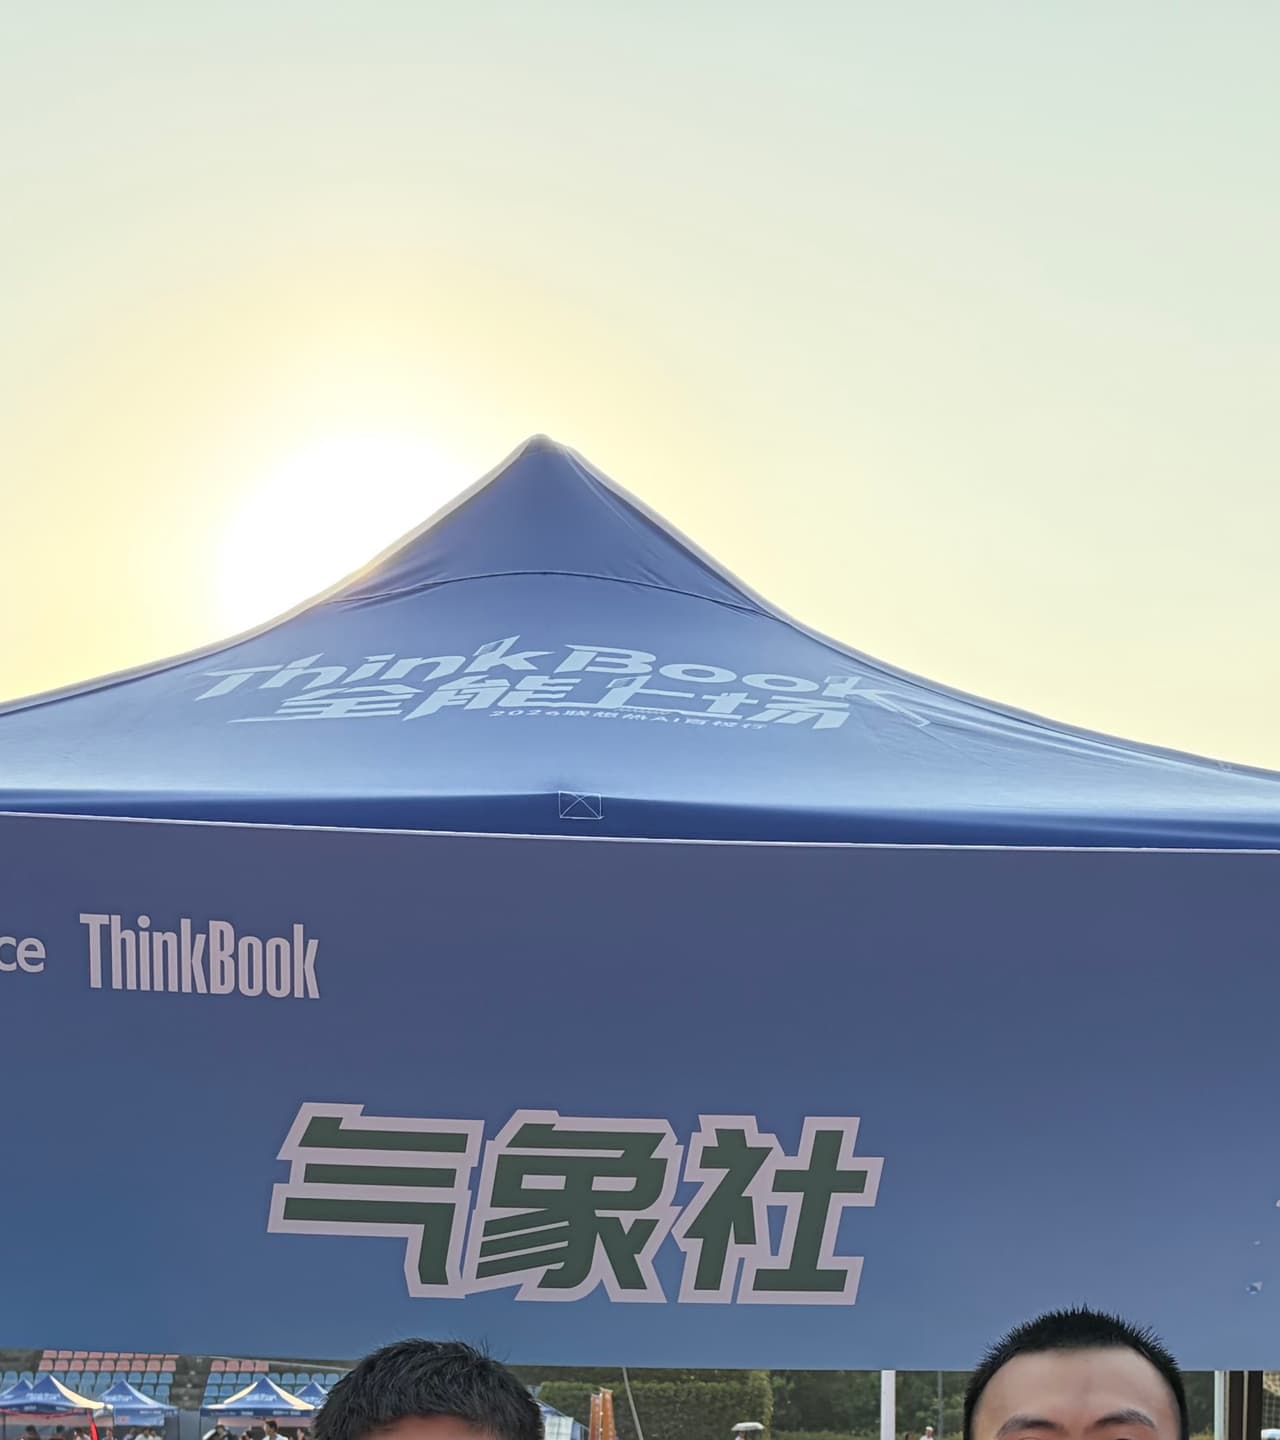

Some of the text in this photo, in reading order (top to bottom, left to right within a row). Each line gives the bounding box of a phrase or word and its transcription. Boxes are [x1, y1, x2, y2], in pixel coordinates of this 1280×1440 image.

[193, 635, 931, 727] ThinkBook
[79, 912, 320, 999] ThinkBook
[267, 1101, 884, 1305] 气象社
